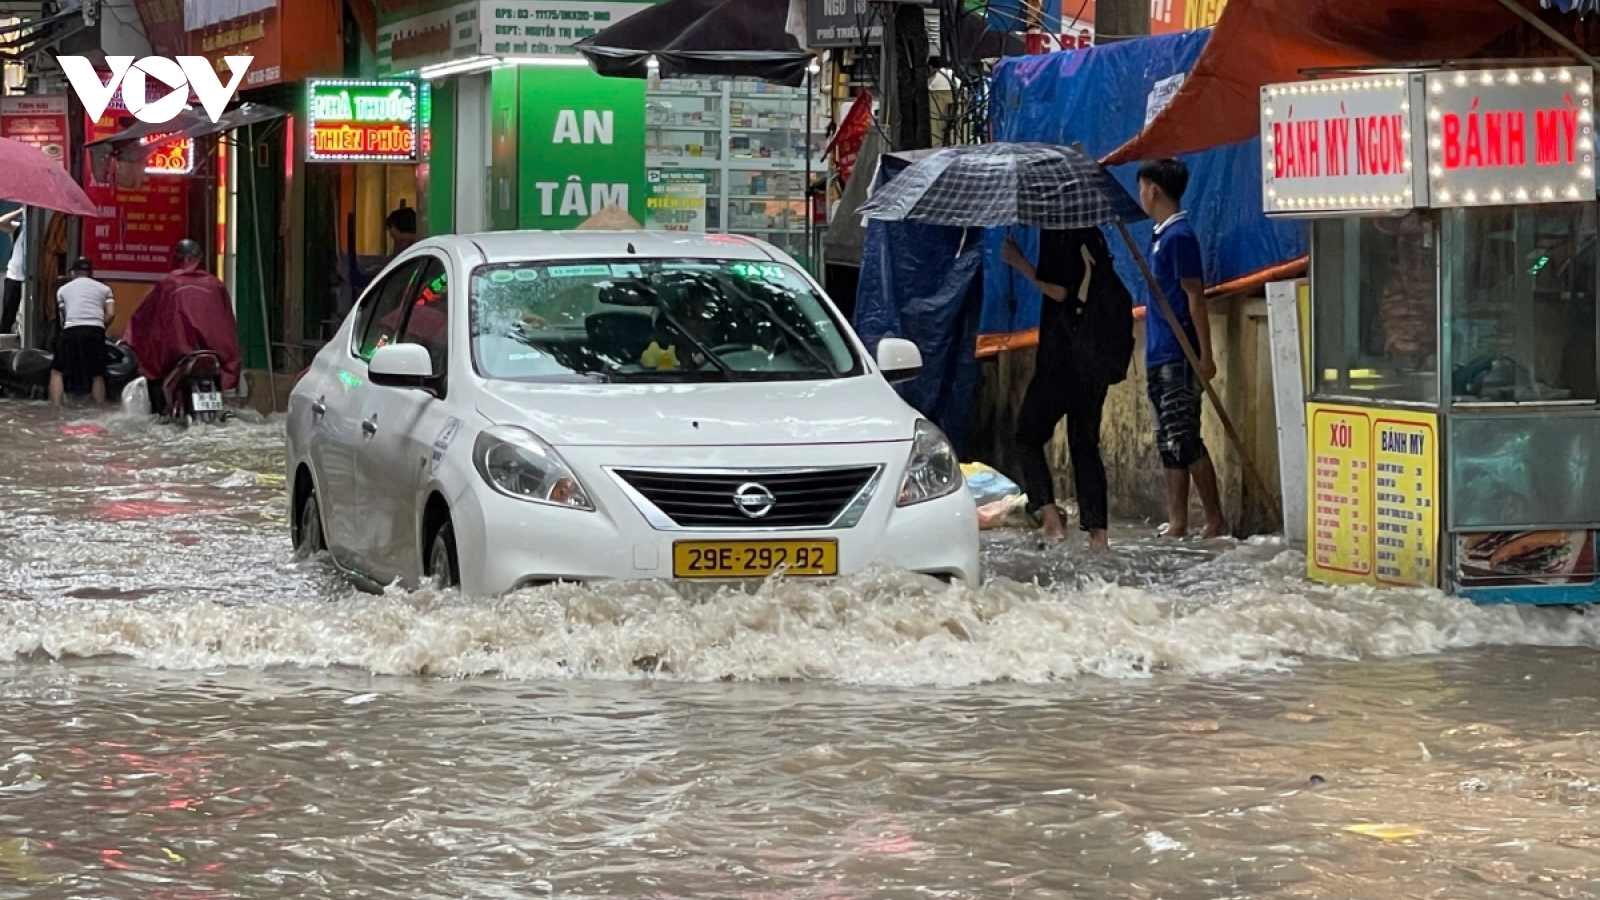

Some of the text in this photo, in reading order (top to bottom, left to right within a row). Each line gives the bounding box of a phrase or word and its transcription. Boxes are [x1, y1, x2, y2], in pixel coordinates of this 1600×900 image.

[315, 89, 413, 121] NHÀ THUỐC
[315, 124, 413, 152] THIÊN PHÚC
[552, 110, 614, 145] AN
[1273, 101, 1404, 178] BÁNH MỲ NGON
[1443, 93, 1578, 169] BÁNH MỲ
[535, 174, 629, 216] TÂM
[1330, 420, 1352, 448] XÔI
[1381, 427, 1425, 456] BÁNH MỲ
